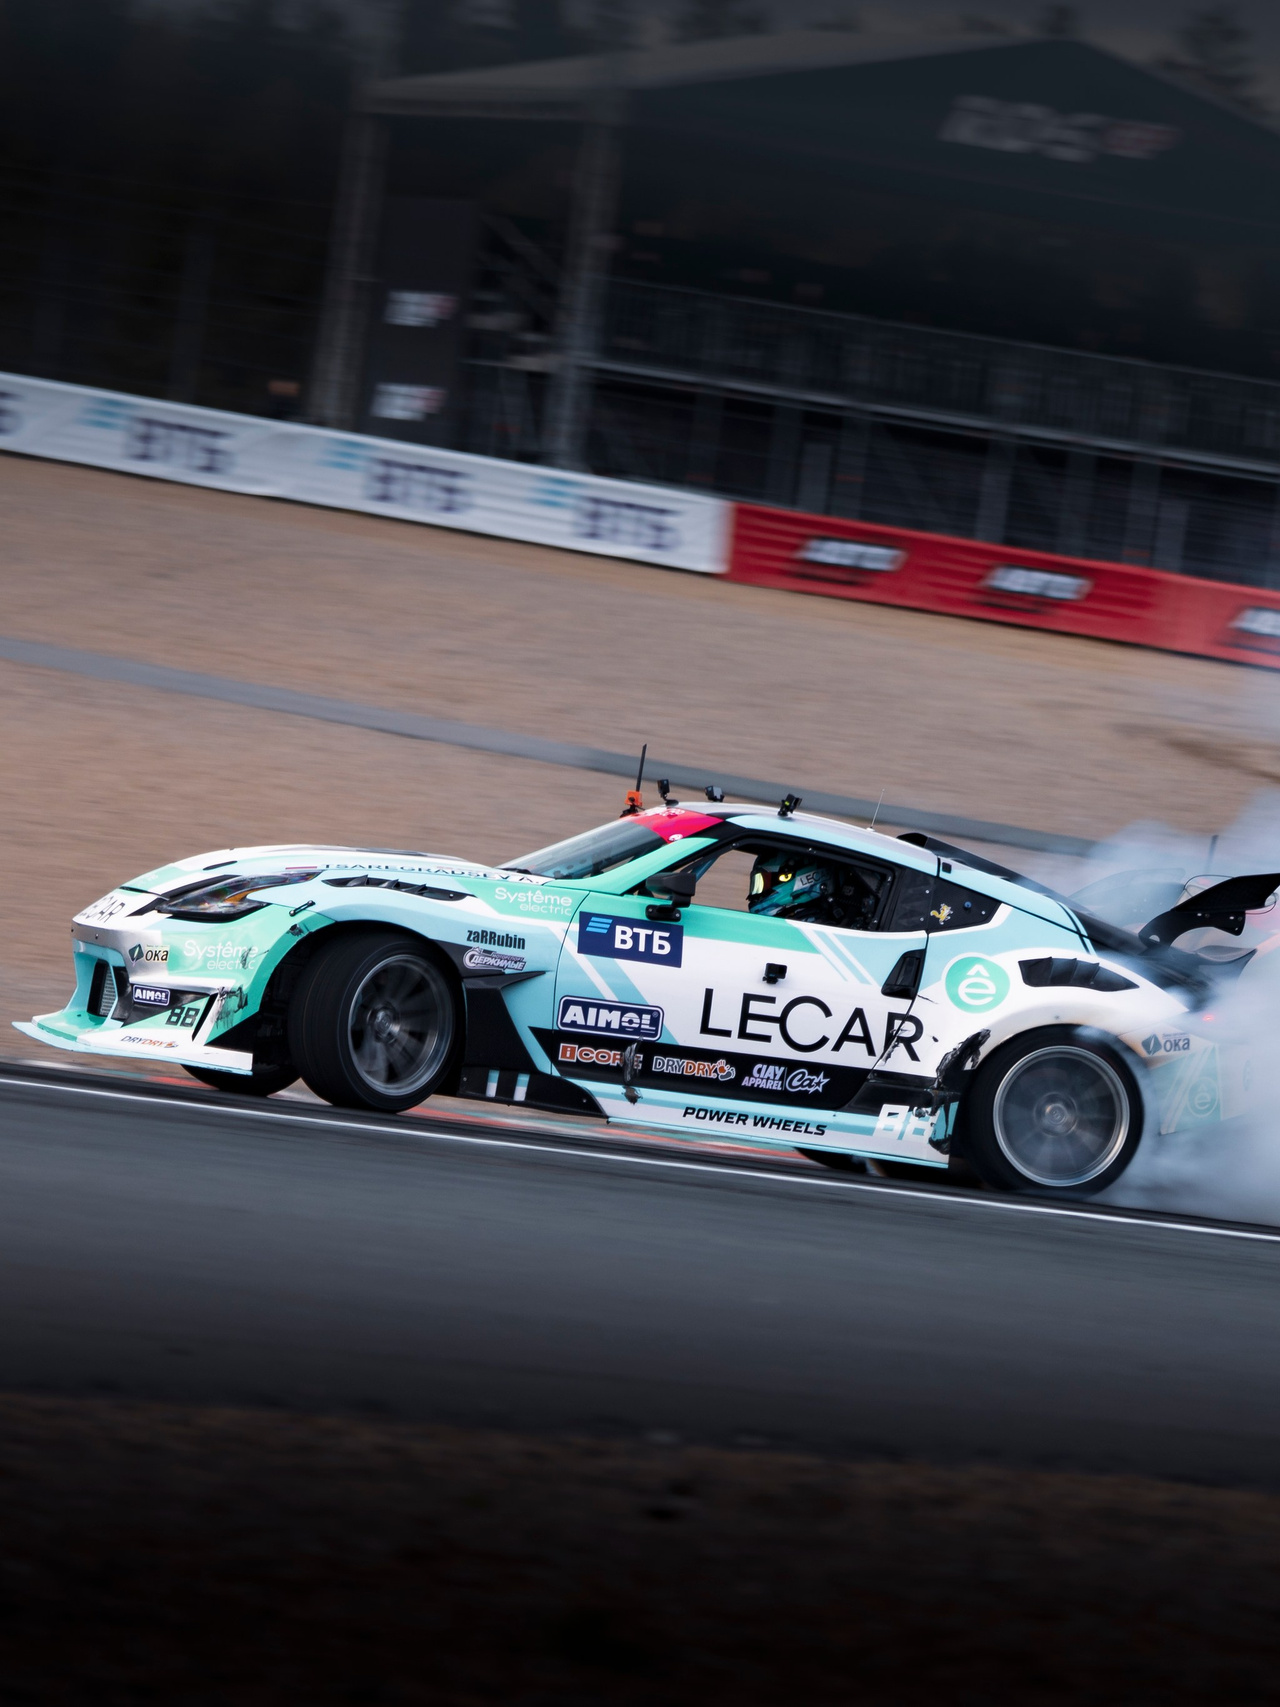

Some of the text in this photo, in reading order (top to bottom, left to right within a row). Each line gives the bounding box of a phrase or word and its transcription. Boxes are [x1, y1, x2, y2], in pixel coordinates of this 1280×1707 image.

[495, 887, 573, 907] Systême
[520, 903, 572, 916] electric
[467, 929, 526, 950] zaRRubin
[614, 925, 672, 955] ВТБ
[135, 988, 168, 1003] AIMOL
[165, 1007, 200, 1027] 88
[562, 1005, 656, 1034] AIMOL
[700, 988, 924, 1062] LECAR
[121, 1035, 167, 1047] DRYDRY
[652, 1055, 717, 1078] DRYDRY
[741, 1076, 783, 1091] APPAREL
[682, 1106, 828, 1137] POWER WHEELS
[873, 1104, 940, 1144] 88
